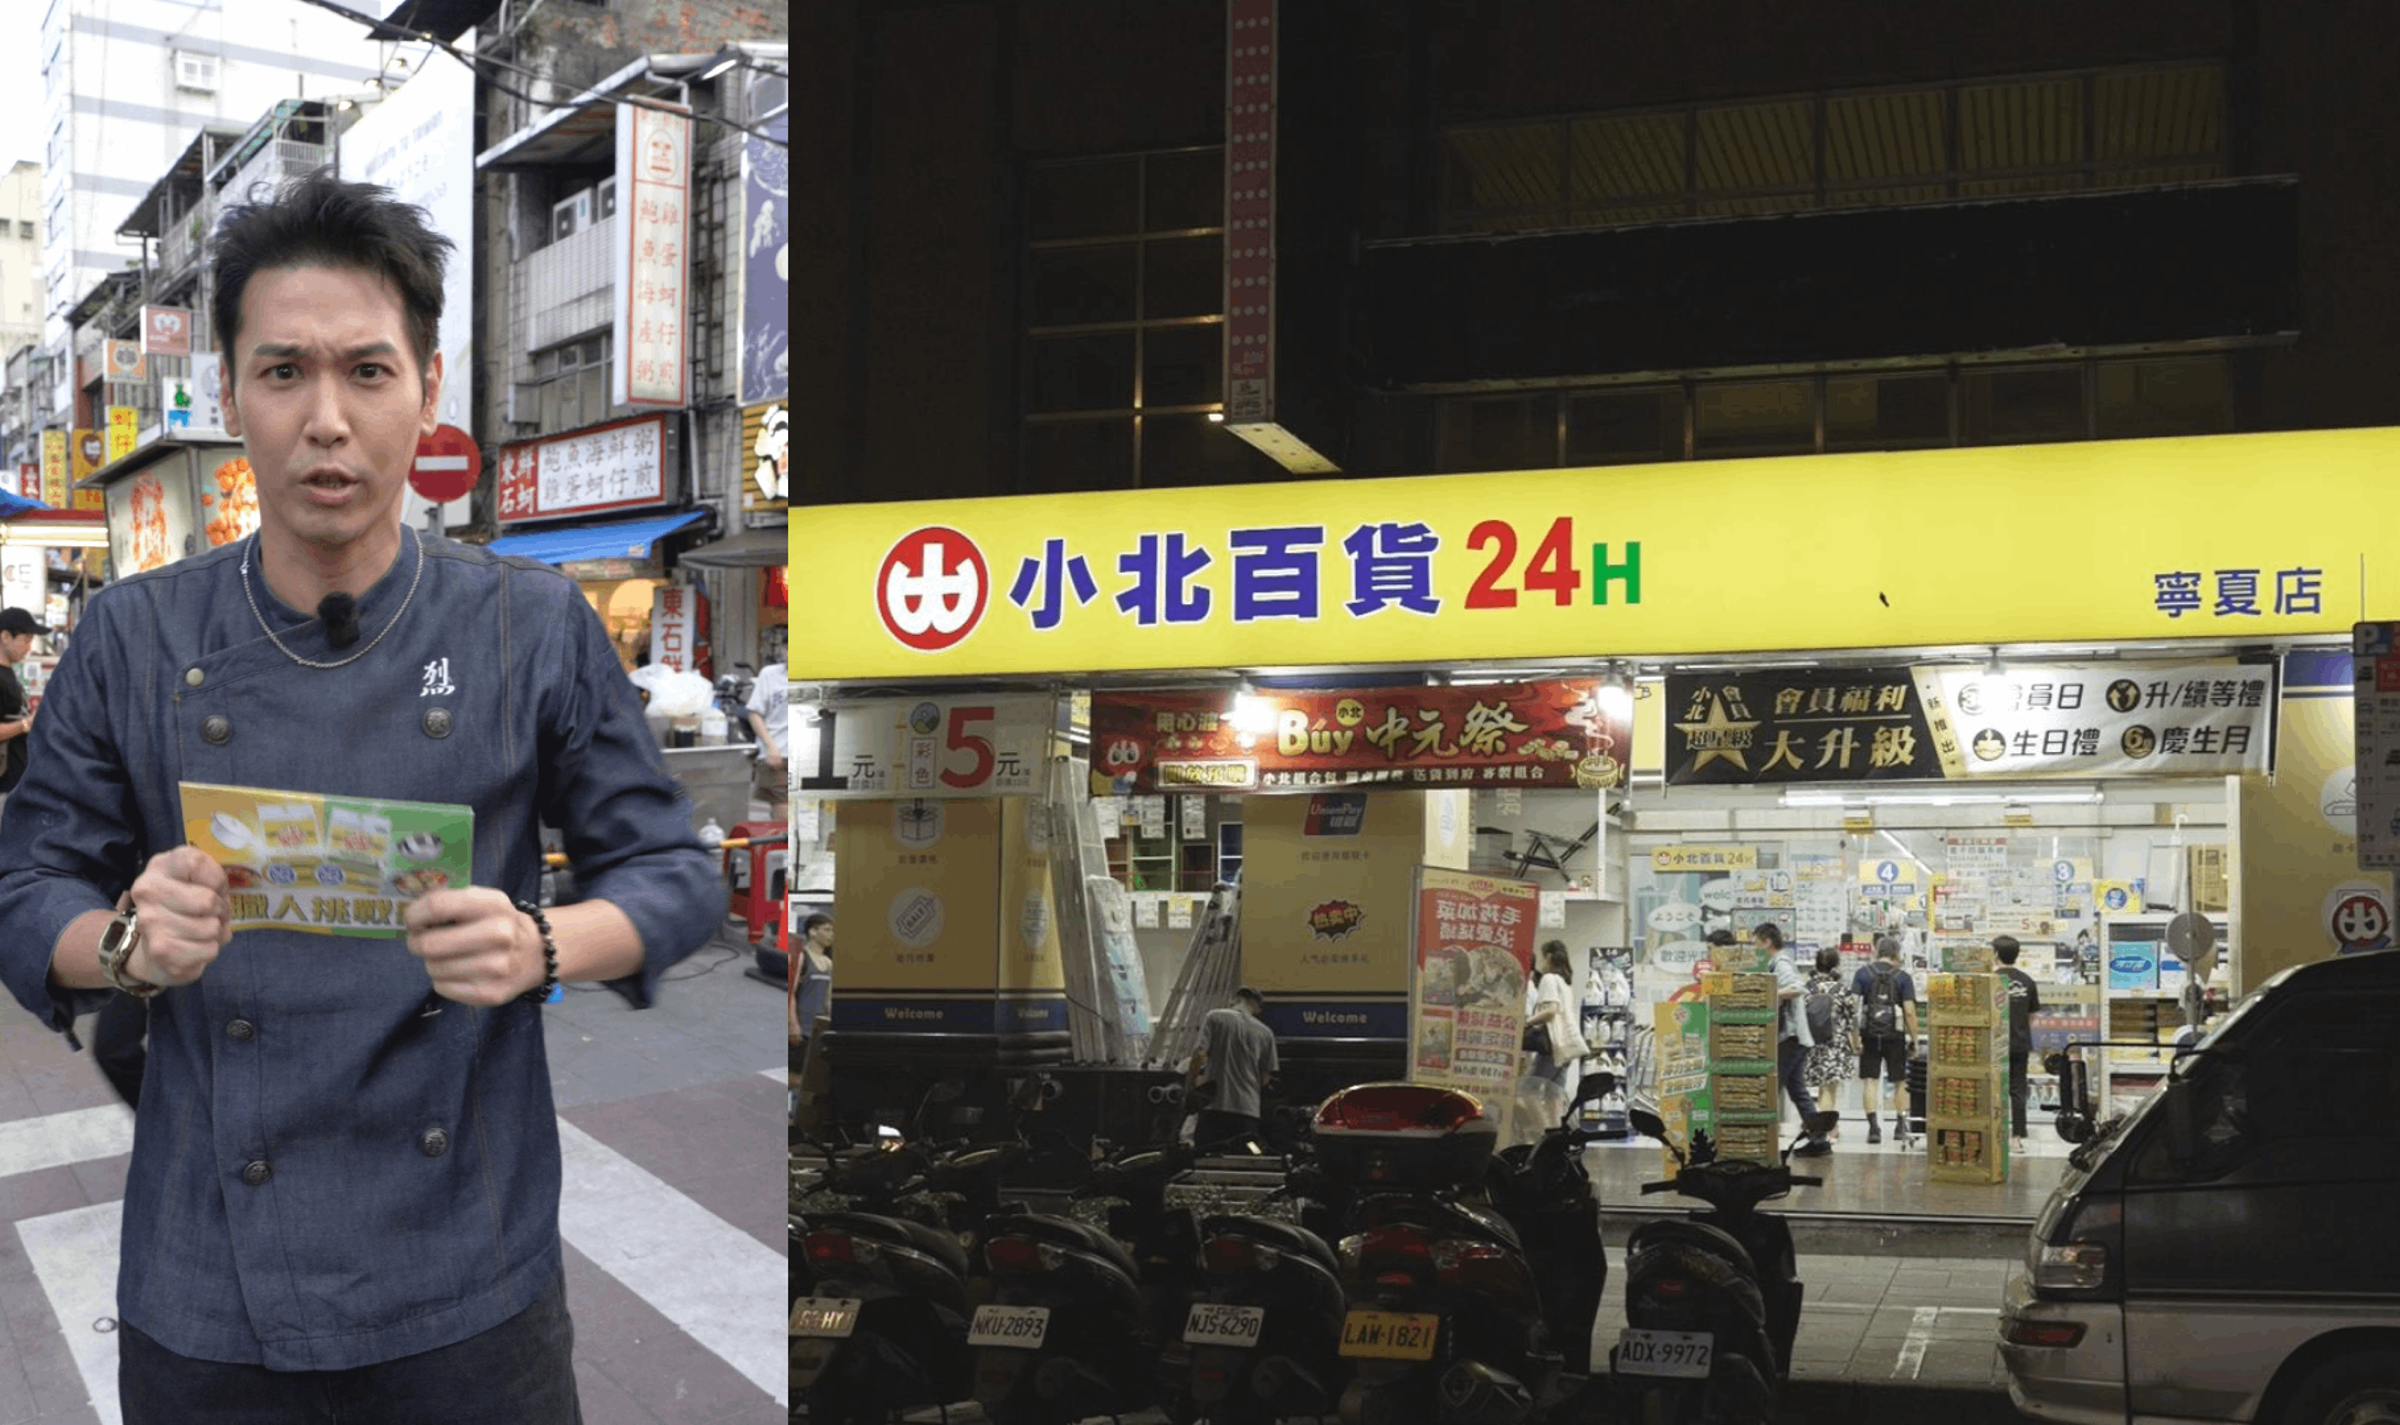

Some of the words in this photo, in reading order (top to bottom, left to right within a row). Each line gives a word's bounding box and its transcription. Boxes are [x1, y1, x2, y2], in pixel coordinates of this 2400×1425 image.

[543, 427, 656, 474] 鮑魚海鮮粥
[543, 462, 656, 504] 雞蛋蚵仔煎
[2154, 567, 2323, 618] 寧夏店
[420, 657, 456, 698] 烈
[1773, 683, 1909, 715] 會員福利
[2144, 679, 2266, 709] 升/續等禮
[1364, 700, 1529, 759] 中元祭
[2010, 726, 2101, 757] 生日禮
[2158, 725, 2252, 755] 慶生月
[939, 705, 995, 789] 5
[1760, 725, 1918, 773] 大升級
[1879, 863, 1895, 881] 4
[884, 1006, 944, 1020] Welcome
[1302, 1010, 1368, 1024] Welcome
[1188, 1313, 1260, 1338] NJS-6290
[1344, 1321, 1431, 1348] LAW-1821
[1620, 1340, 1710, 1366] ADX-9972
